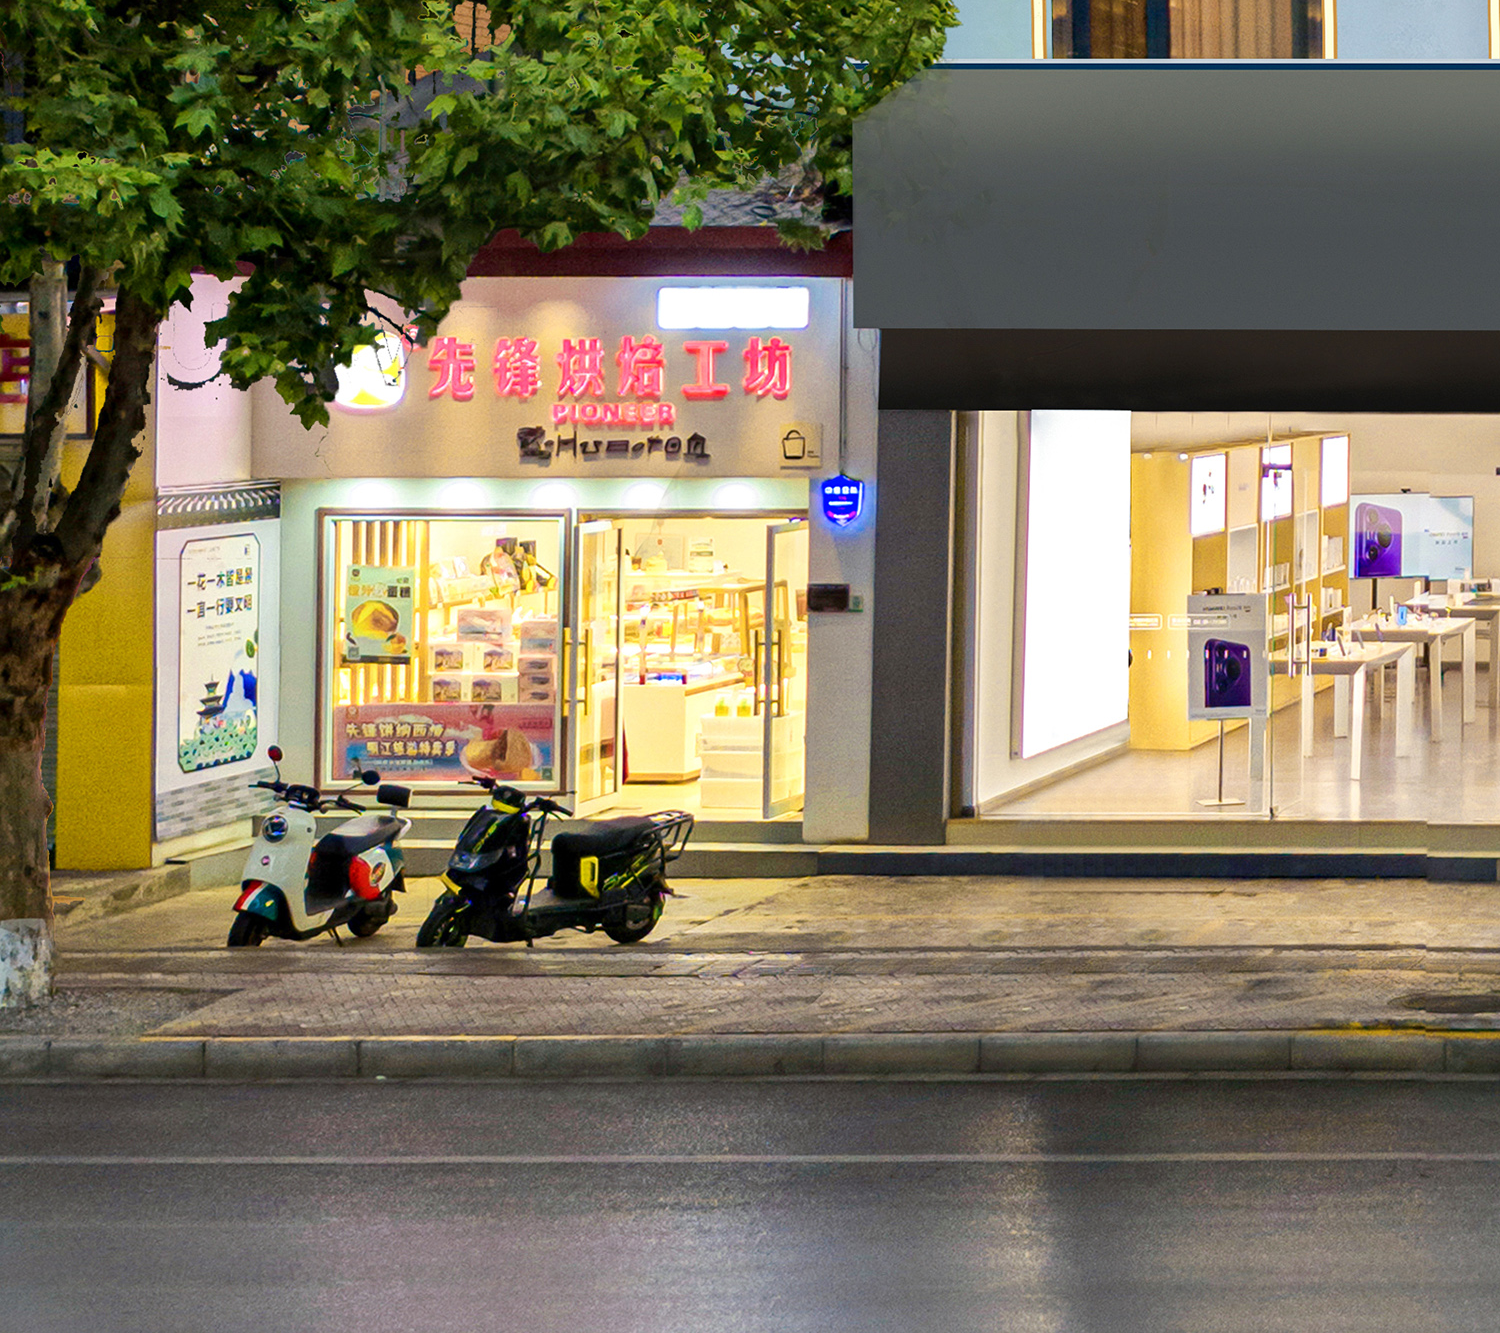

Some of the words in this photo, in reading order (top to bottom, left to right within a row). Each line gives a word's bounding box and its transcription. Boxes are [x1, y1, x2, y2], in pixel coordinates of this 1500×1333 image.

[427, 335, 794, 400] 先锋烘焙工坊
[552, 402, 676, 425] PIONEER
